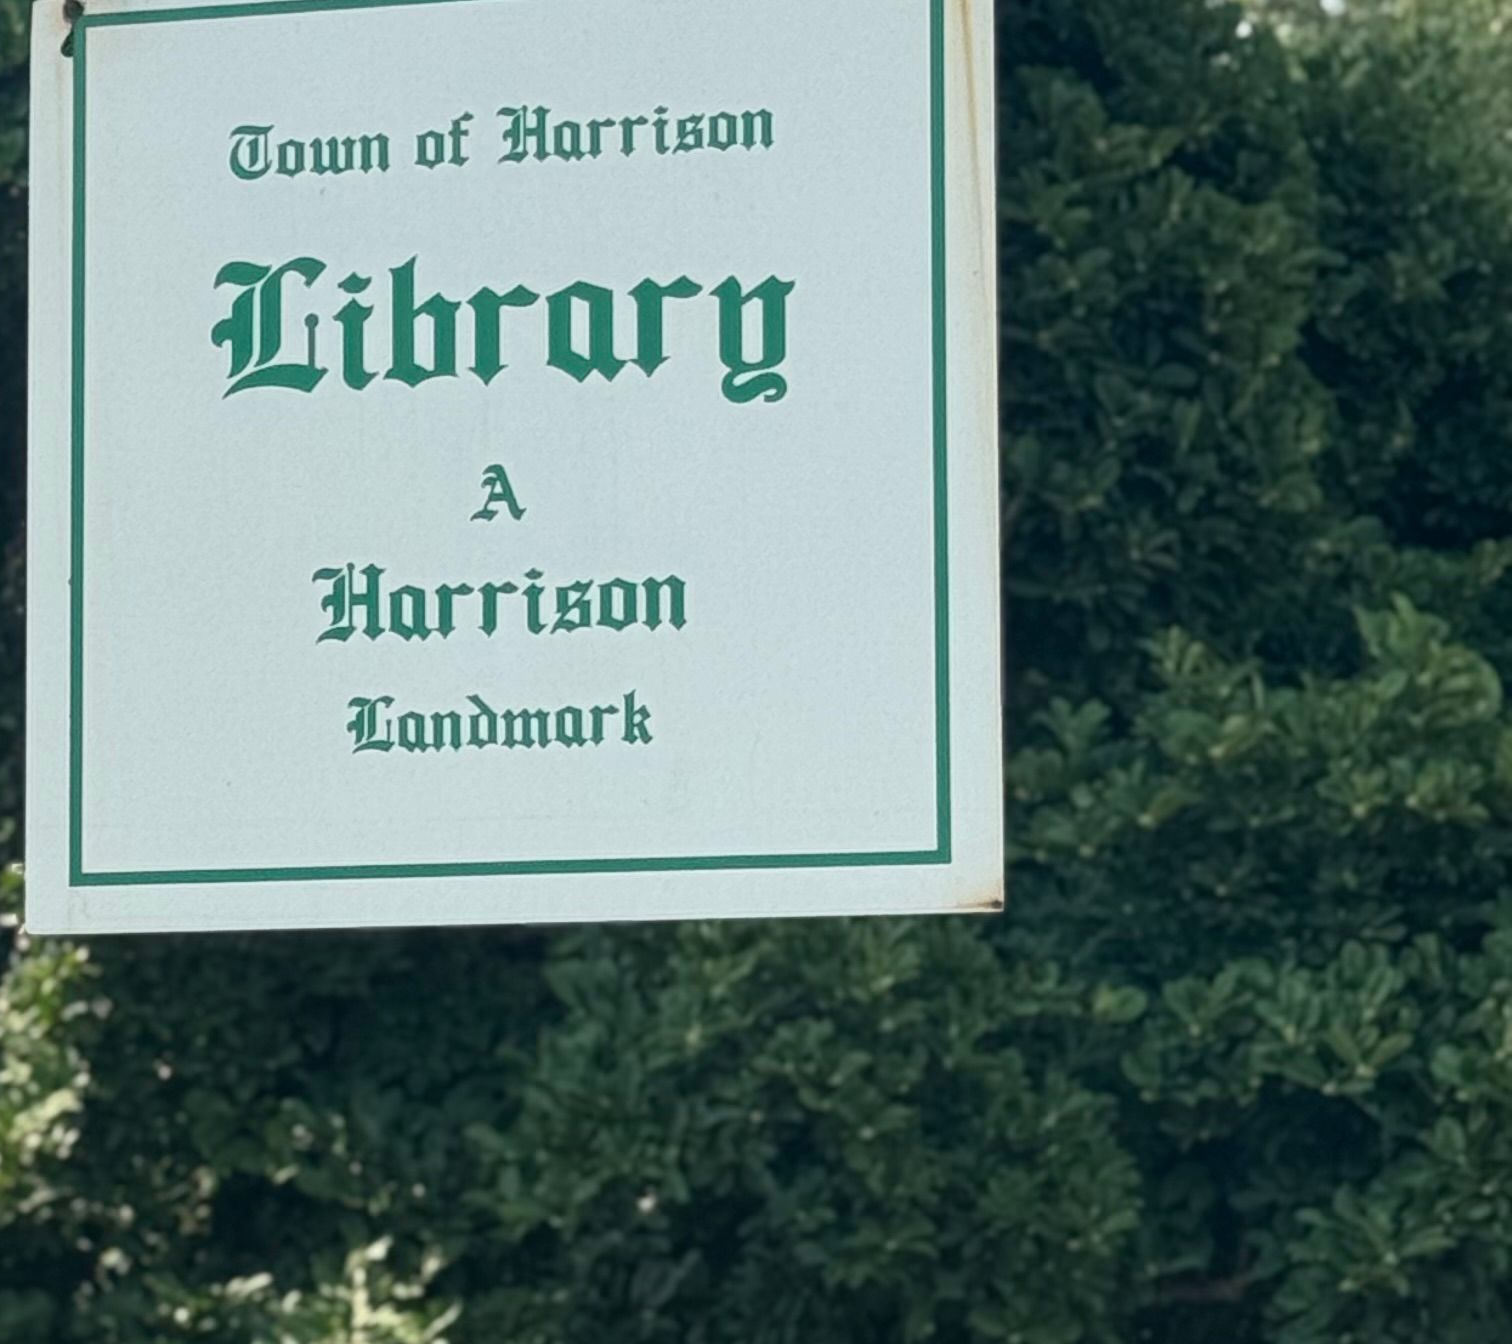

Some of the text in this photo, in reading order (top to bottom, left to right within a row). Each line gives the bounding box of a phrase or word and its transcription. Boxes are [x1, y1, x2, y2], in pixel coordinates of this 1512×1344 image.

[229, 104, 775, 181] Town of Harrison
[210, 255, 796, 404] Library
[470, 463, 527, 522] A
[311, 562, 687, 643] Harrison
[346, 689, 653, 754] Landmark
